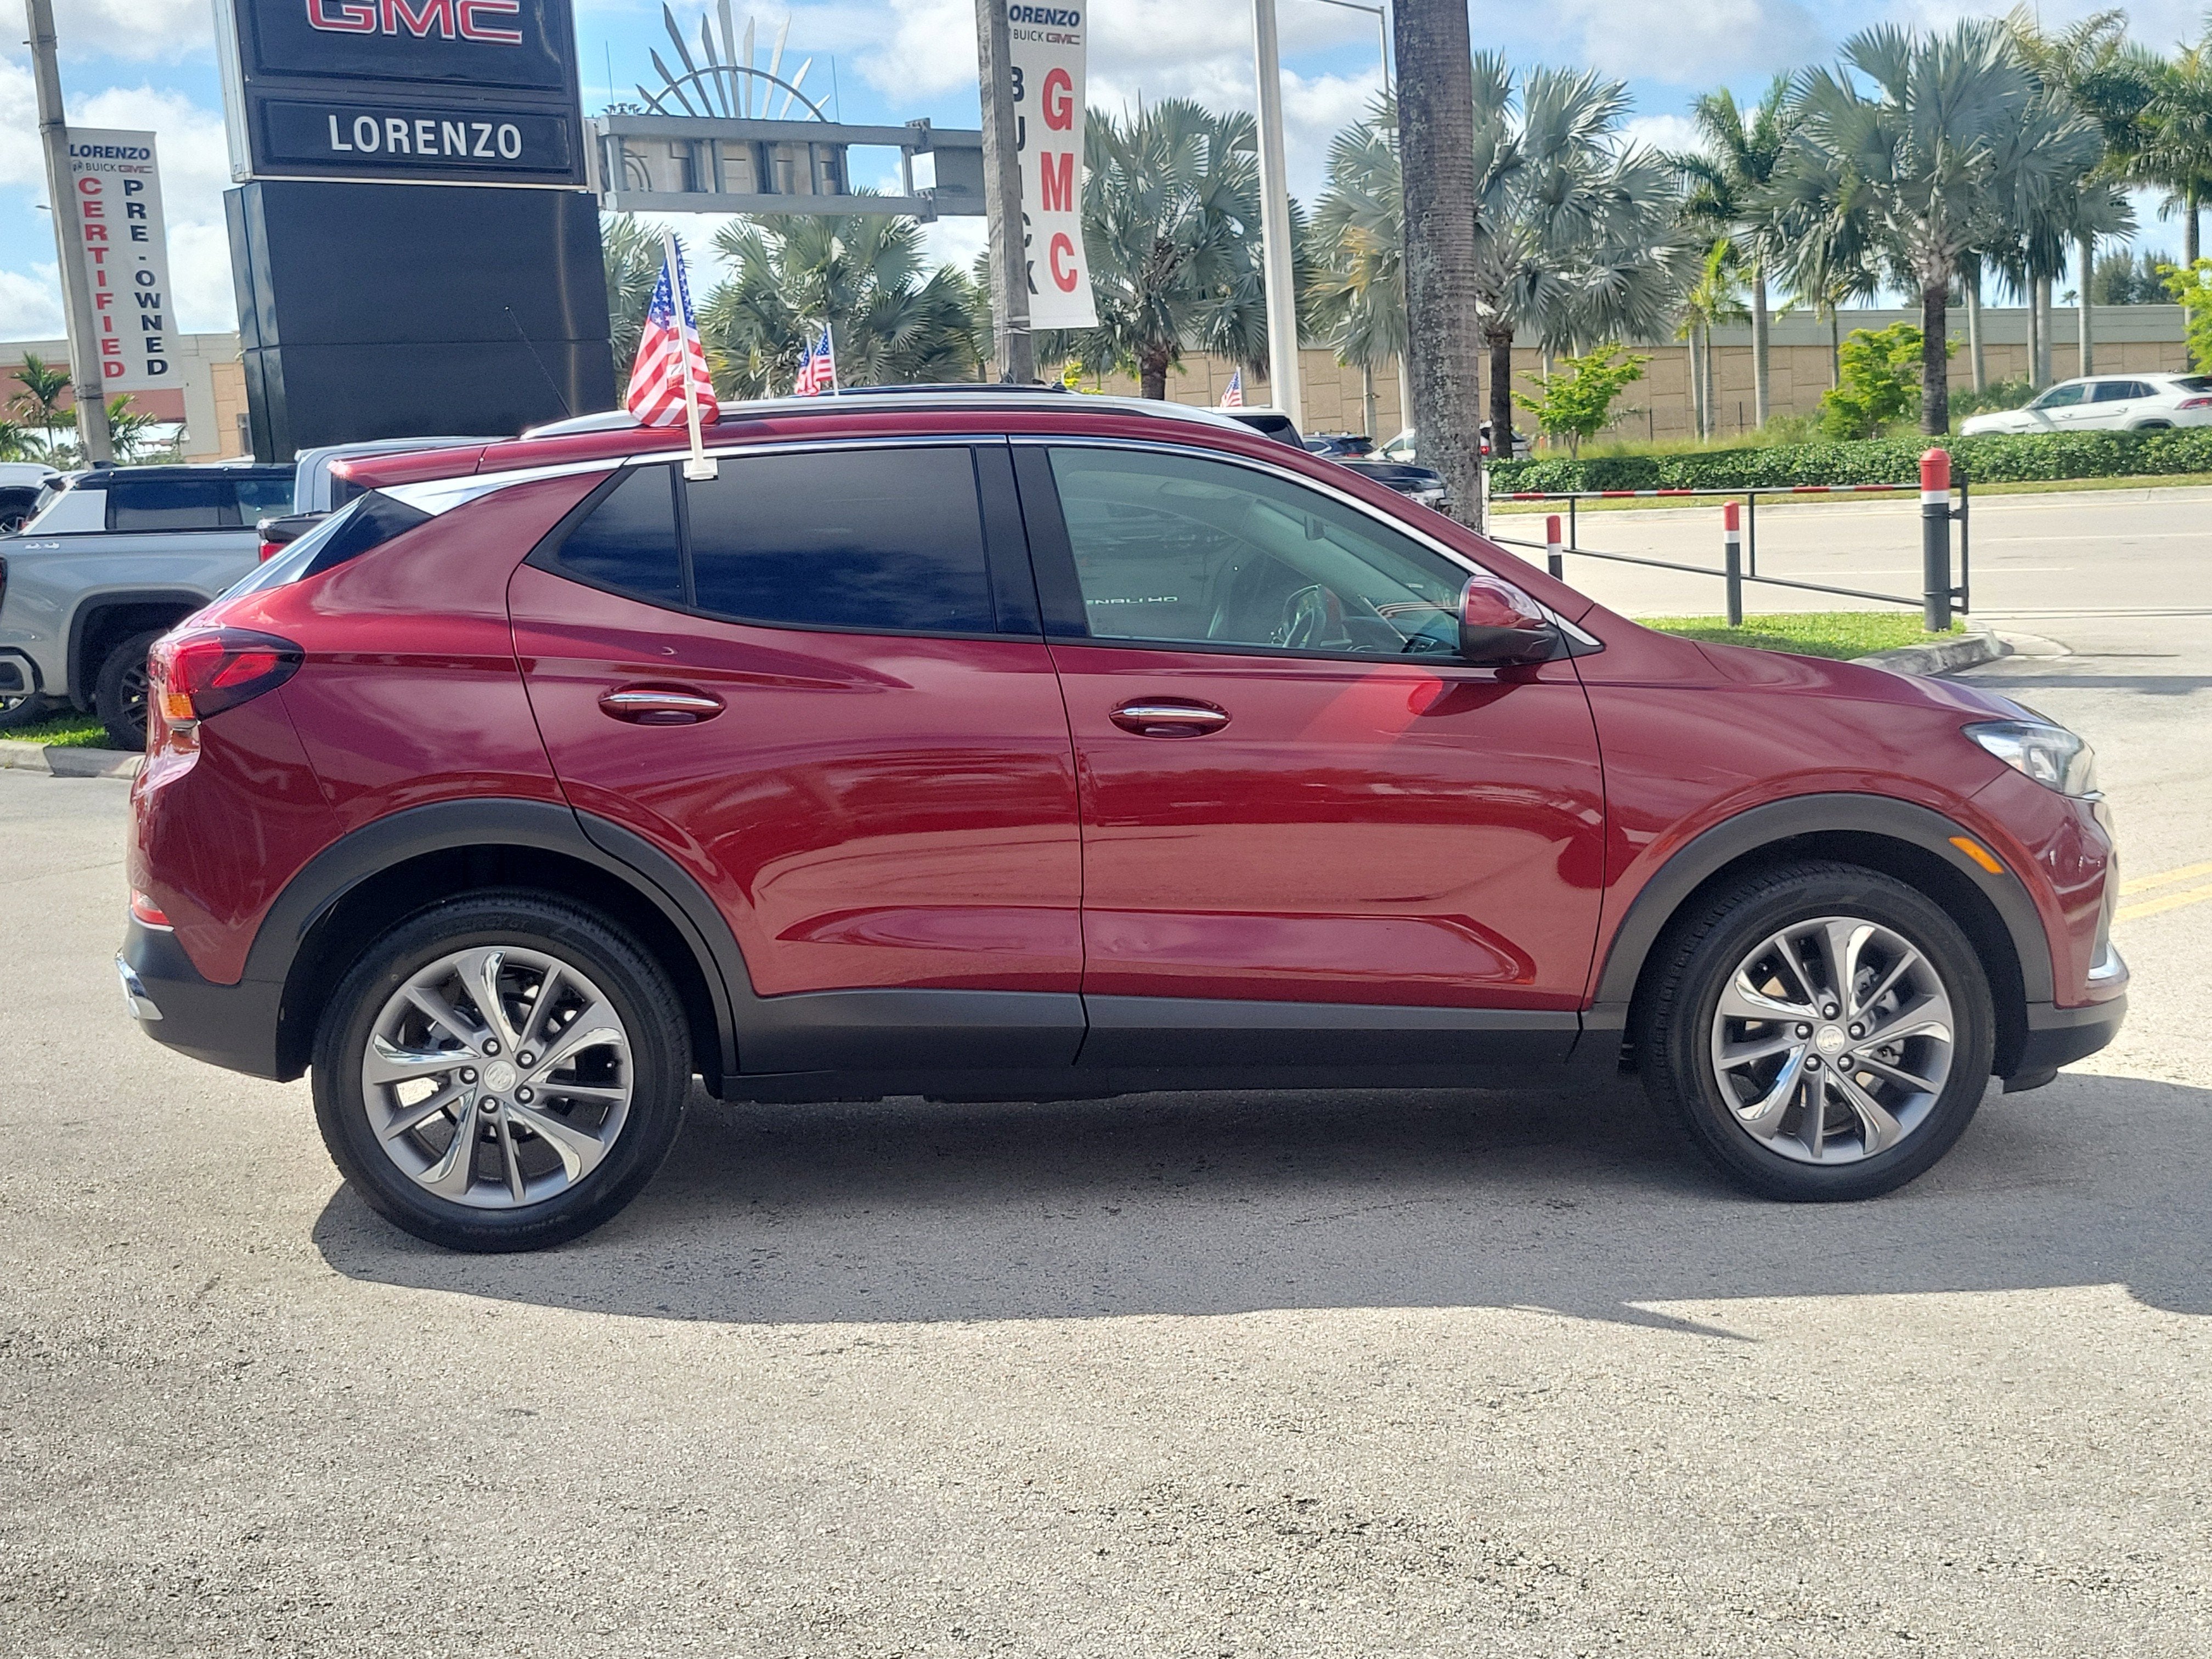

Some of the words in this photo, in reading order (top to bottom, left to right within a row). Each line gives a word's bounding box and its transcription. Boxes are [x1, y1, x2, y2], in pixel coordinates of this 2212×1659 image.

[306, 0, 522, 45] GMC
[1009, 5, 1081, 27] ORENZO
[1014, 29, 1043, 42] BUICK
[1046, 32, 1081, 45] GMC
[70, 144, 150, 160] LORENZO
[329, 115, 522, 160] LORENZO
[86, 162, 117, 173] BUICK
[119, 165, 154, 174] GMC
[1040, 68, 1078, 293] GMC
[78, 177, 126, 379] CERTIFIED
